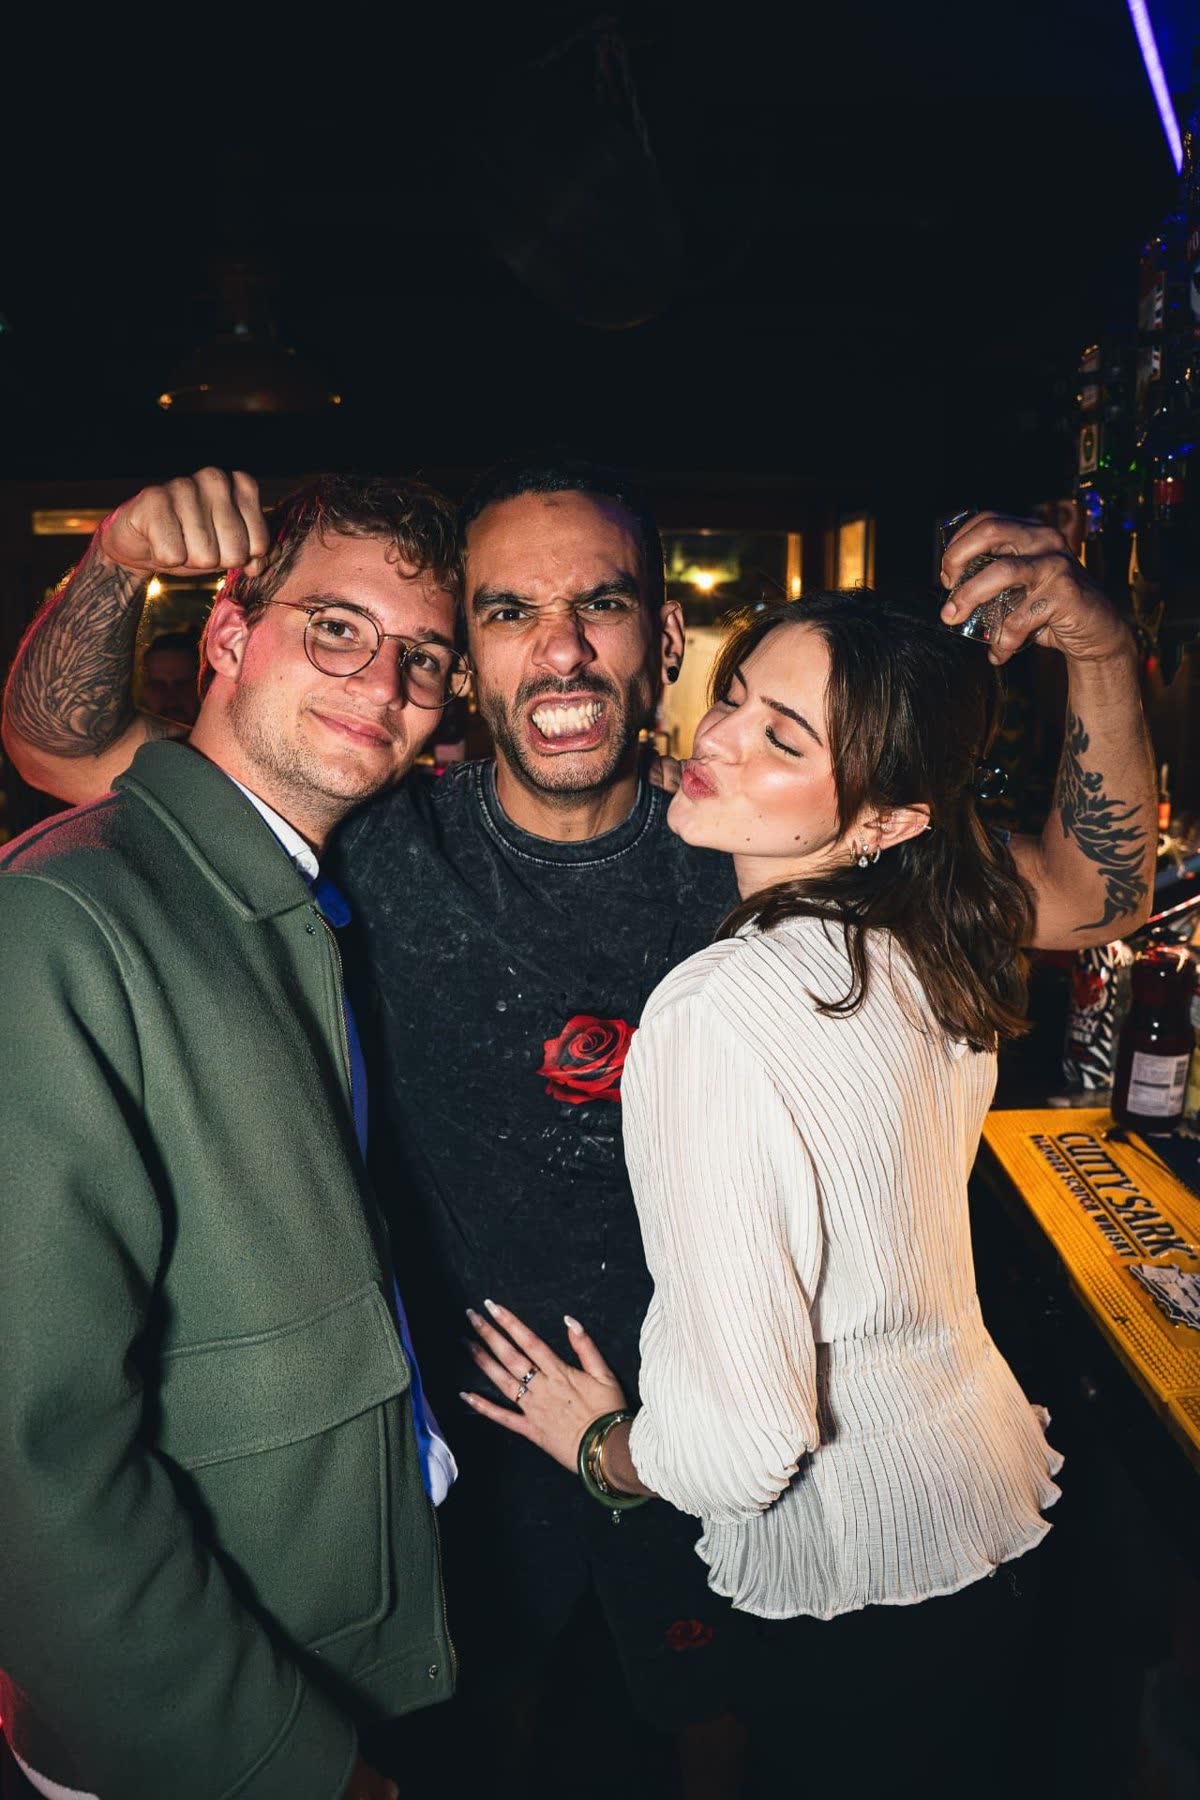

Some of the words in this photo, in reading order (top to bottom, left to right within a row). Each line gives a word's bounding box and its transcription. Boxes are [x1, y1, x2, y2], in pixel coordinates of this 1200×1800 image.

[1057, 1131, 1140, 1192] CUTTY
[1104, 1195, 1194, 1258] SARK
[1061, 1175, 1101, 1211] SCOTCH
[1093, 1214, 1139, 1257] WHISKY
